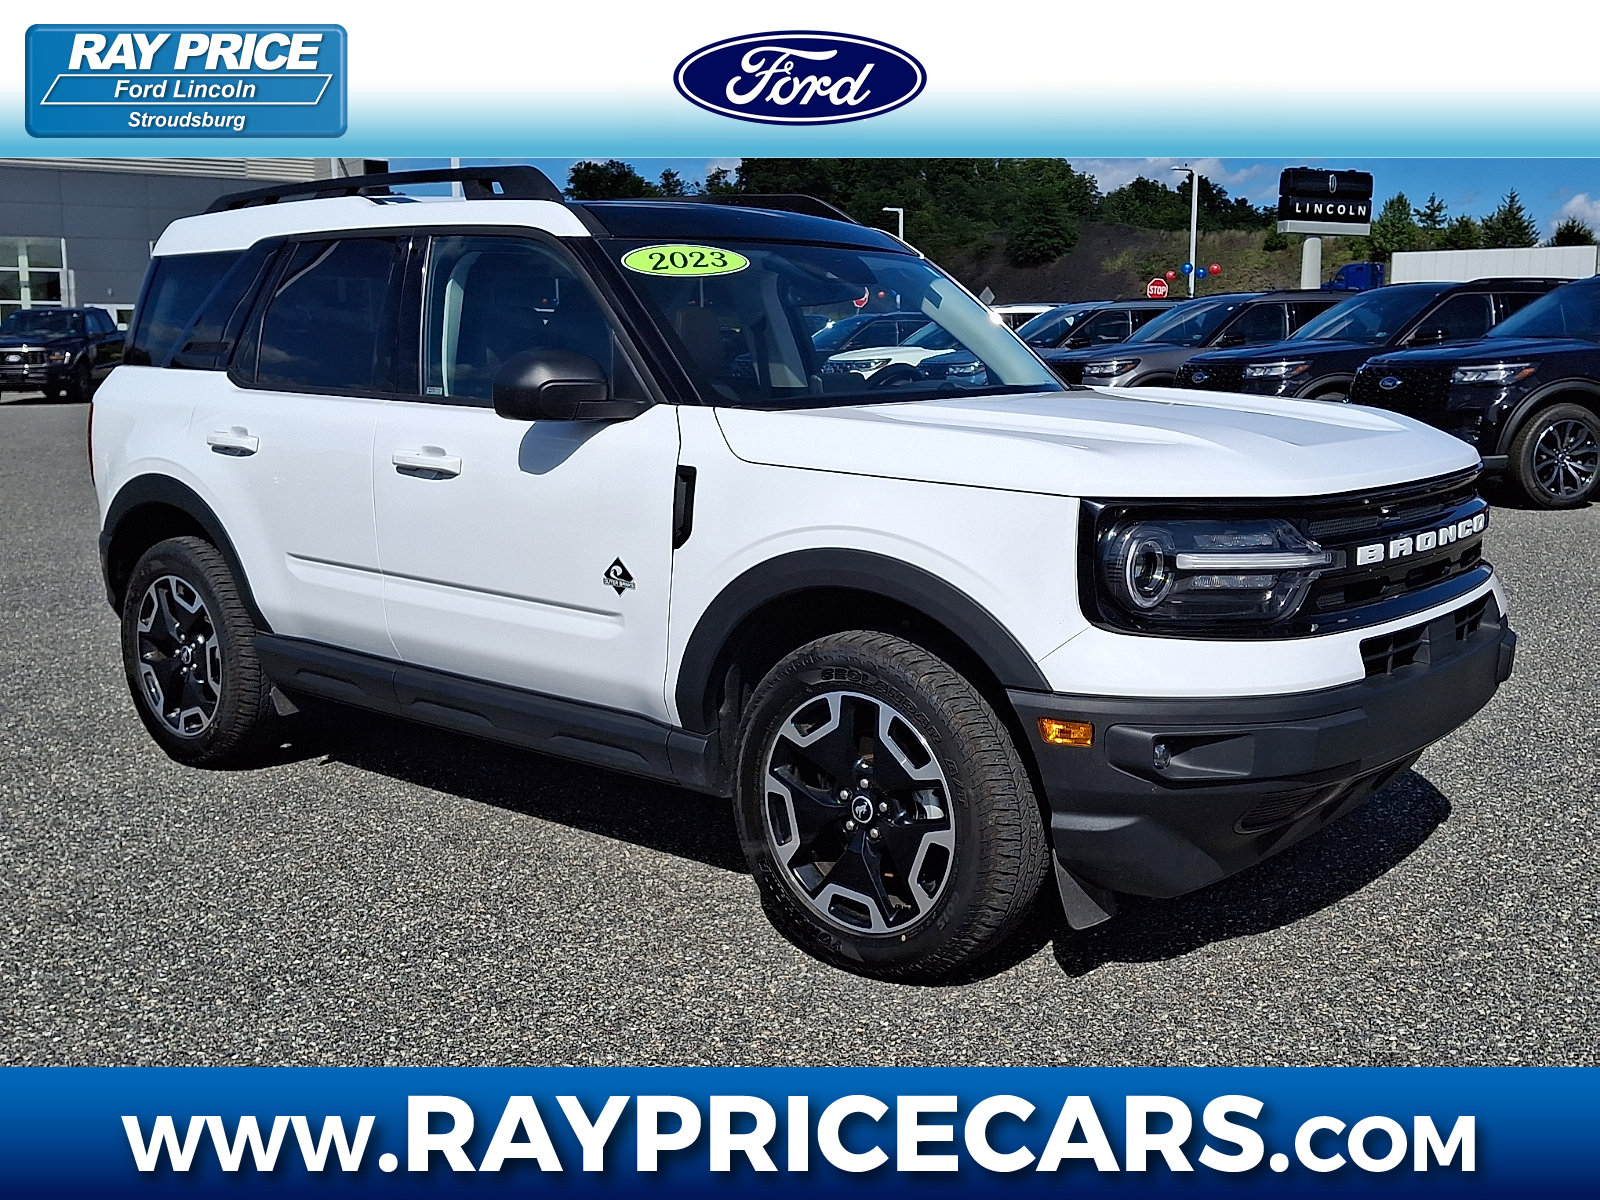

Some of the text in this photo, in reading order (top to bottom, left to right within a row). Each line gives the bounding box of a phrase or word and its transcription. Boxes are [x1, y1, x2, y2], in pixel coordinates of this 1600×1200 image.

[1295, 202, 1366, 217] LINCOLN
[649, 251, 728, 271] 2023
[1149, 285, 1167, 296] STOP
[1356, 513, 1485, 566] BRONCO
